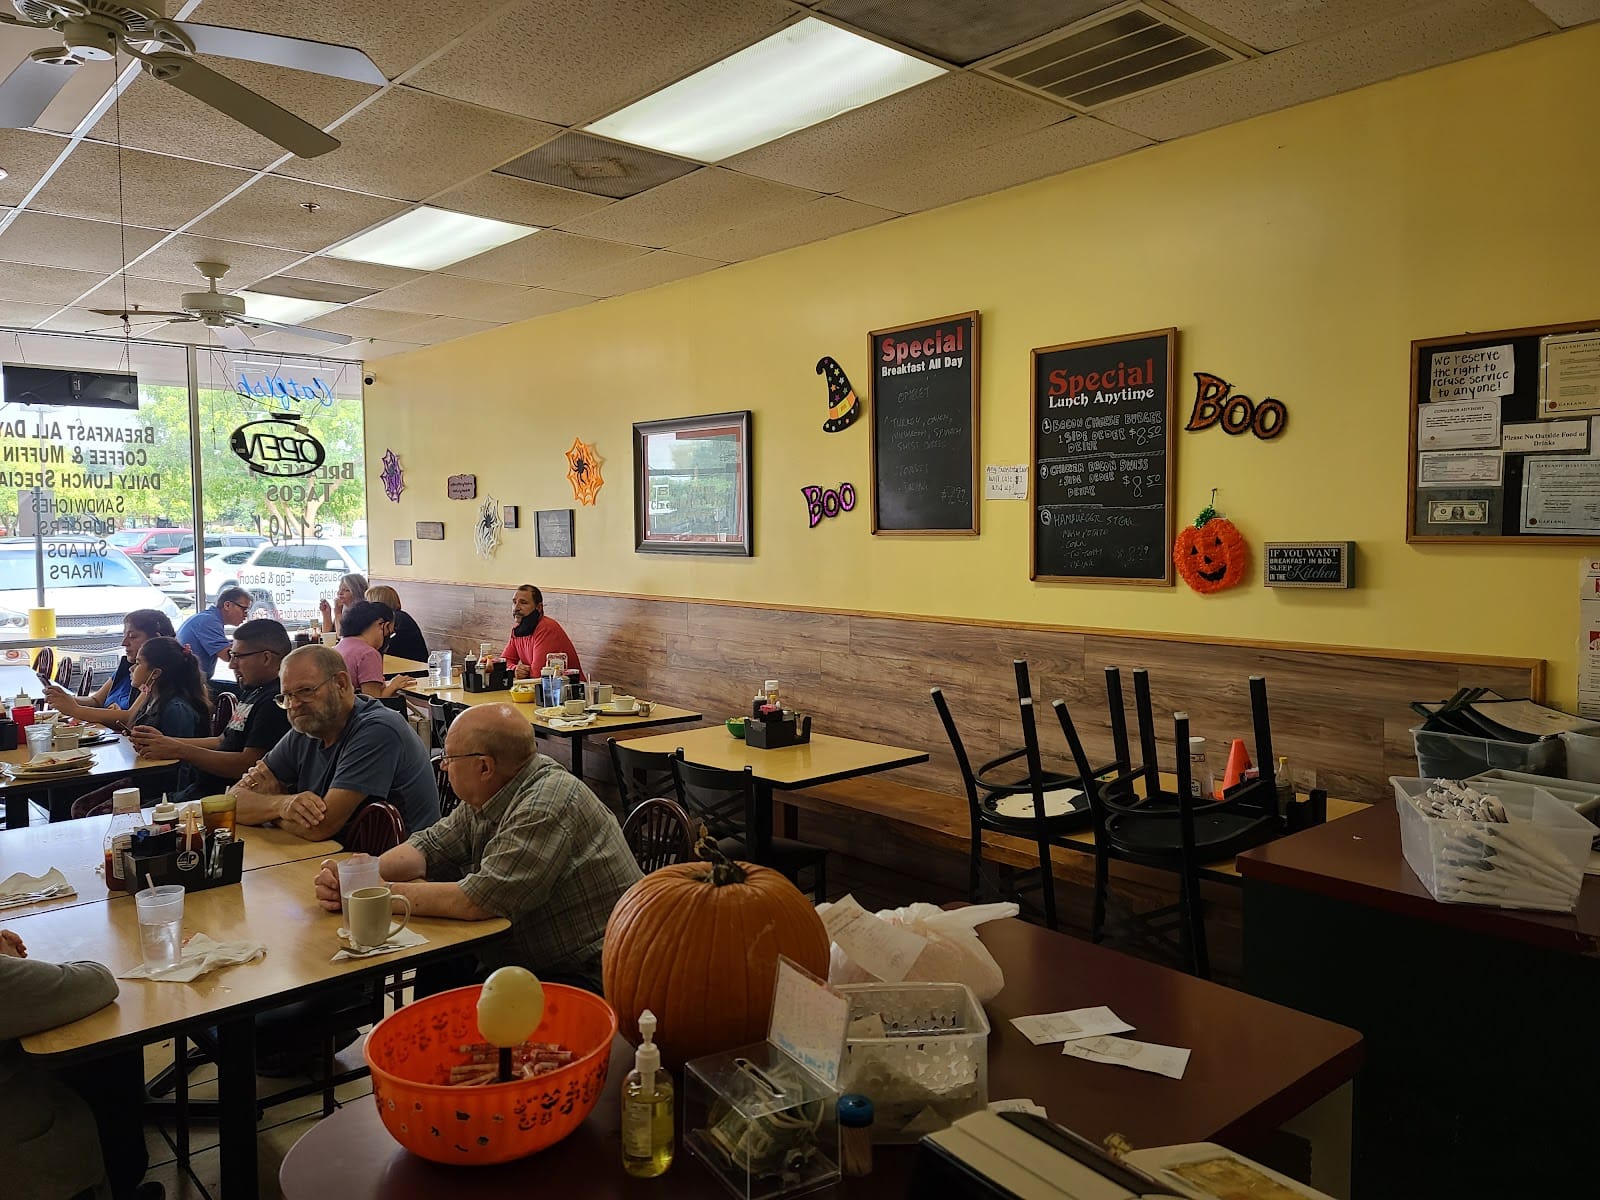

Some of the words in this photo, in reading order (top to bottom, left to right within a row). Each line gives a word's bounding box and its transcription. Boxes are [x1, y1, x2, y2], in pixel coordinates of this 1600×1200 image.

[882, 326, 963, 365] Special
[1455, 351, 1500, 364] reserve
[881, 361, 925, 377] Breakfast
[929, 358, 941, 370] All
[944, 357, 963, 369] Day
[1433, 368, 1450, 377] the
[1454, 364, 1480, 376] right
[1484, 363, 1496, 372] to
[1048, 358, 1153, 399] Special
[1433, 377, 1466, 387] refuse
[1469, 371, 1509, 384] service
[1049, 393, 1089, 408] Lunch
[1093, 388, 1155, 405] Anytime
[1439, 388, 1449, 397] to
[1453, 381, 1501, 399] anyone!
[1535, 432, 1560, 440] Outside
[1270, 549, 1280, 557] IF
[1283, 549, 1303, 557] YOU
[1306, 549, 1338, 557] WANT
[1287, 565, 1337, 580] Kitchen
